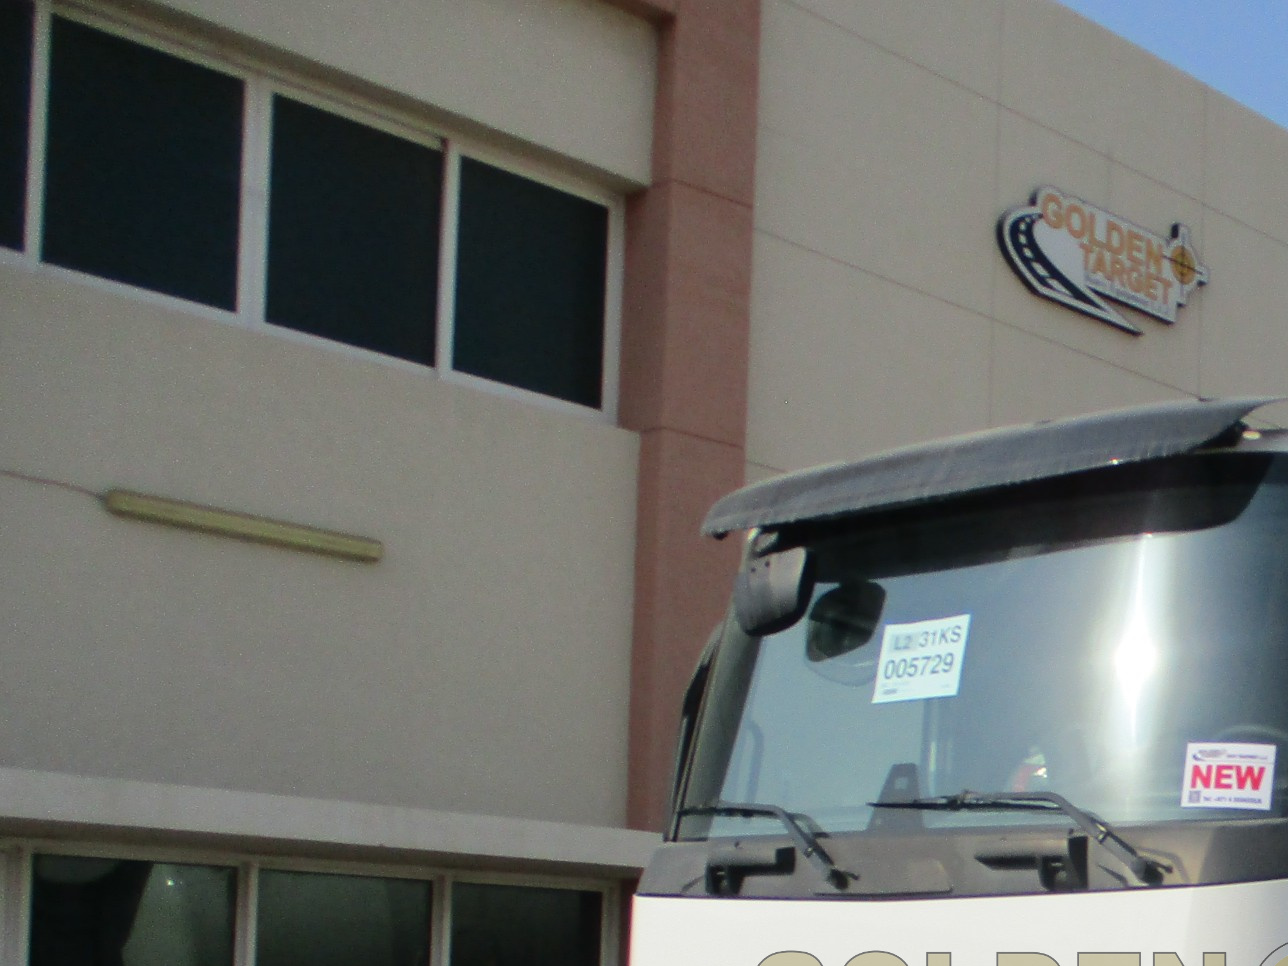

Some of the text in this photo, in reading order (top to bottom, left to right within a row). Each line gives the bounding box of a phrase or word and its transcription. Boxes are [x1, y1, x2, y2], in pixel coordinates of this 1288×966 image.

[1042, 192, 1164, 275] GOLDEN
[1080, 242, 1172, 305] TARGET
[884, 652, 955, 680] 005729
[1190, 764, 1266, 792] NEW
